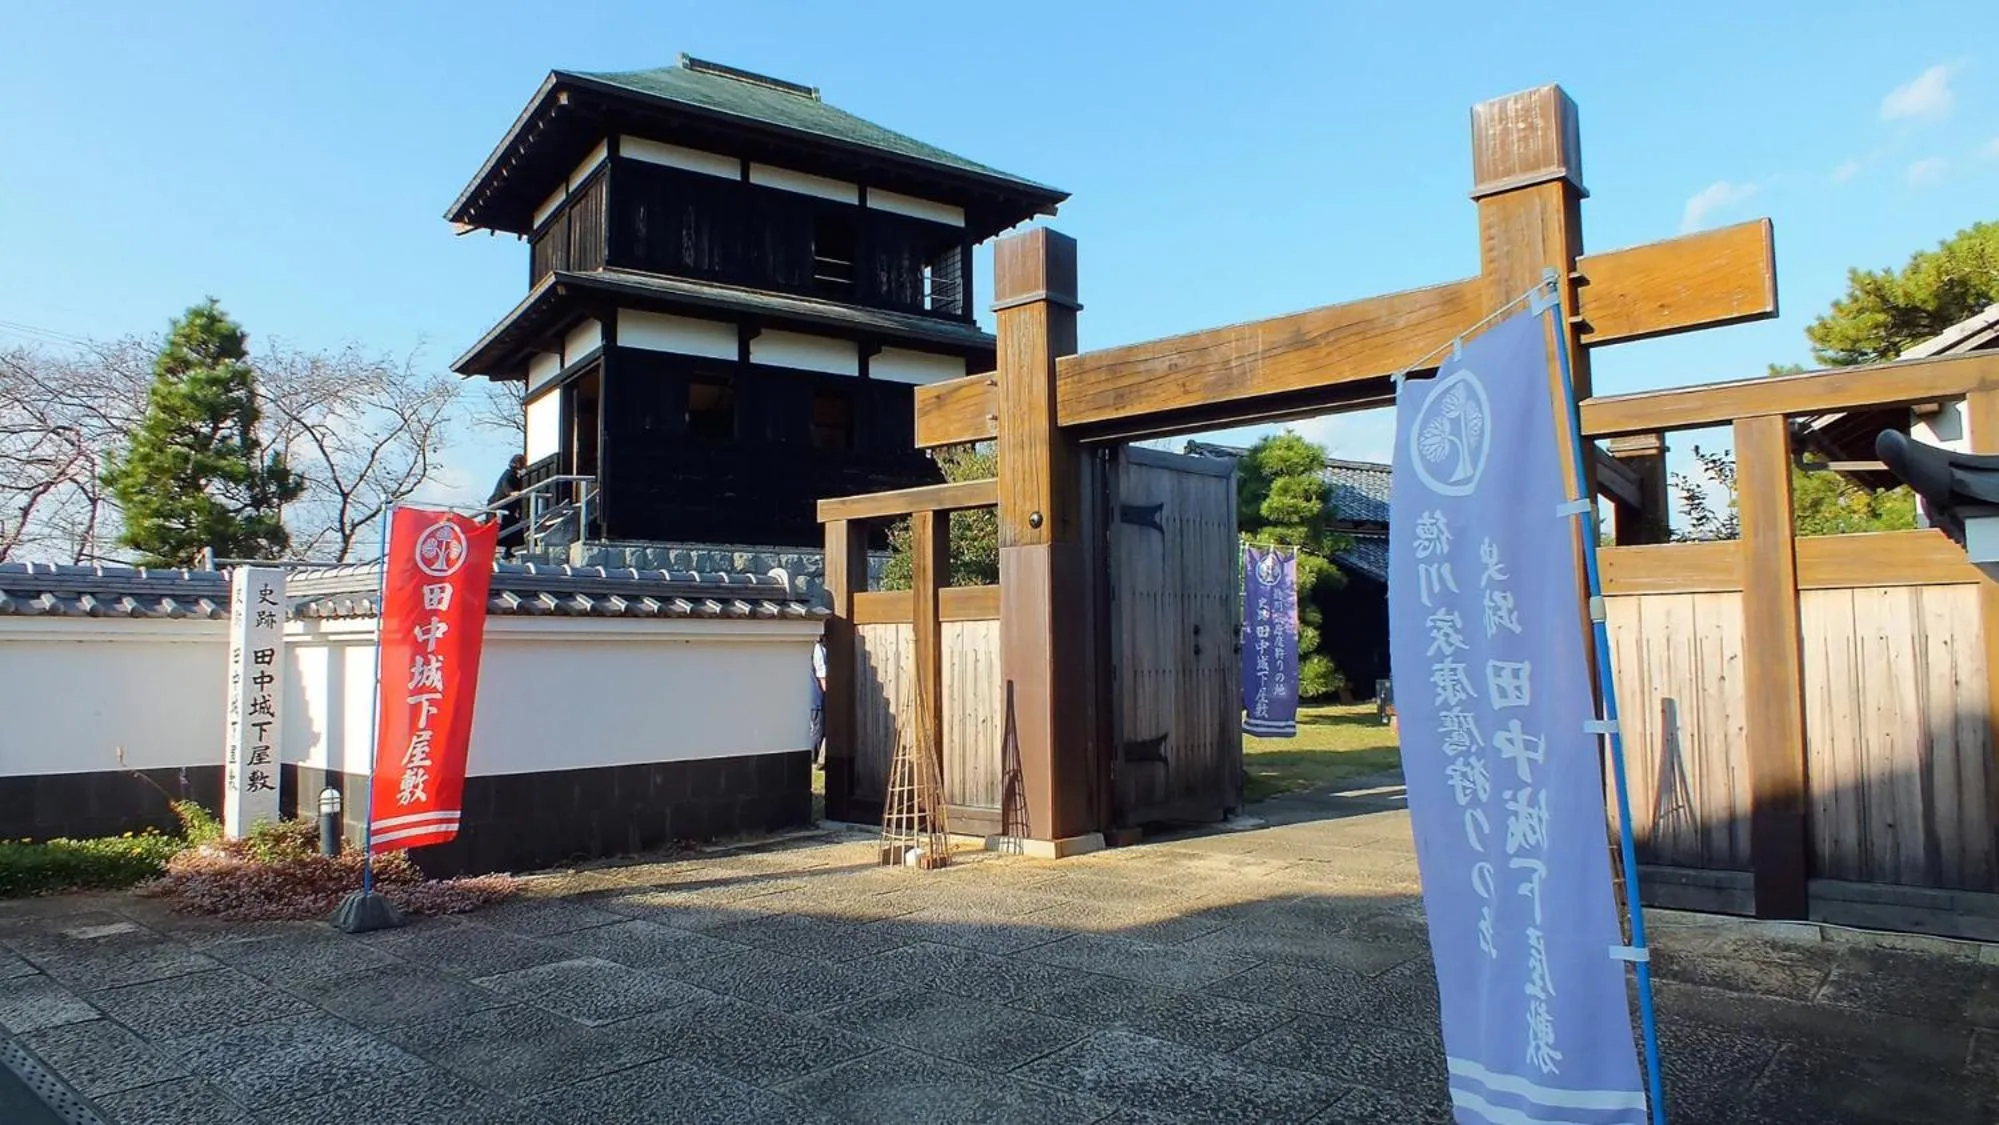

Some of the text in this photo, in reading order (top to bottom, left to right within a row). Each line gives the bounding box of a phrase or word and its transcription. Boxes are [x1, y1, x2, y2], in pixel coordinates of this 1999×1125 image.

[247, 583, 279, 792] 史跡 田中城下屋敷
[396, 583, 453, 805] 田中城下屋敷
